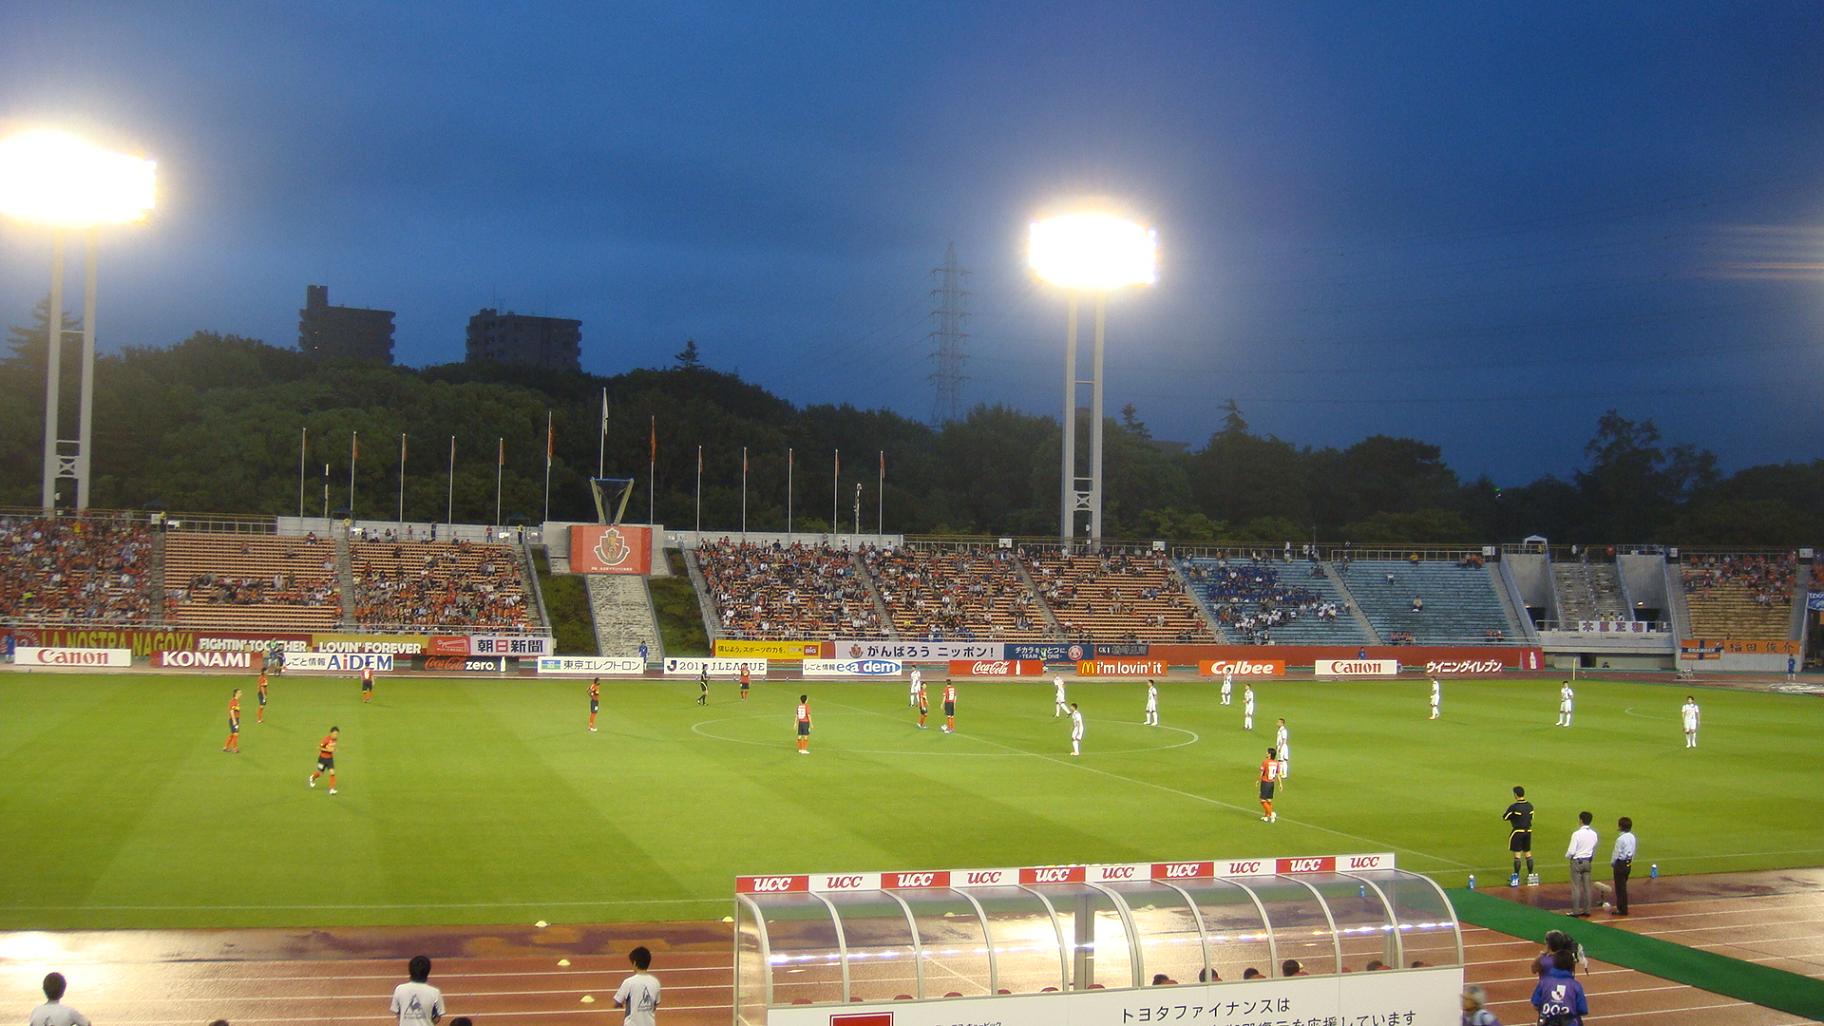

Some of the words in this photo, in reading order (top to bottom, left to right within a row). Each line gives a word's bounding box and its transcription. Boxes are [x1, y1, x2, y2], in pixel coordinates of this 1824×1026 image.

[67, 632, 127, 649] NOSTRA
[132, 633, 195, 656] NAGOYA
[319, 641, 363, 653] LOVIN'
[364, 642, 421, 654] FOREVER
[477, 639, 543, 653] 朝日新聞
[37, 649, 109, 665] Canon
[867, 645, 930, 657] がんばろう
[162, 651, 250, 667] KONAMI
[563, 659, 641, 671] 東京エレクトロン
[1096, 661, 1115, 674] i'm
[1117, 661, 1151, 674] lovin'
[1153, 661, 1162, 674] it
[1211, 661, 1274, 674] Calbee
[1331, 661, 1381, 673] Canon
[1121, 997, 1291, 1024] トヨタファイナンスは
